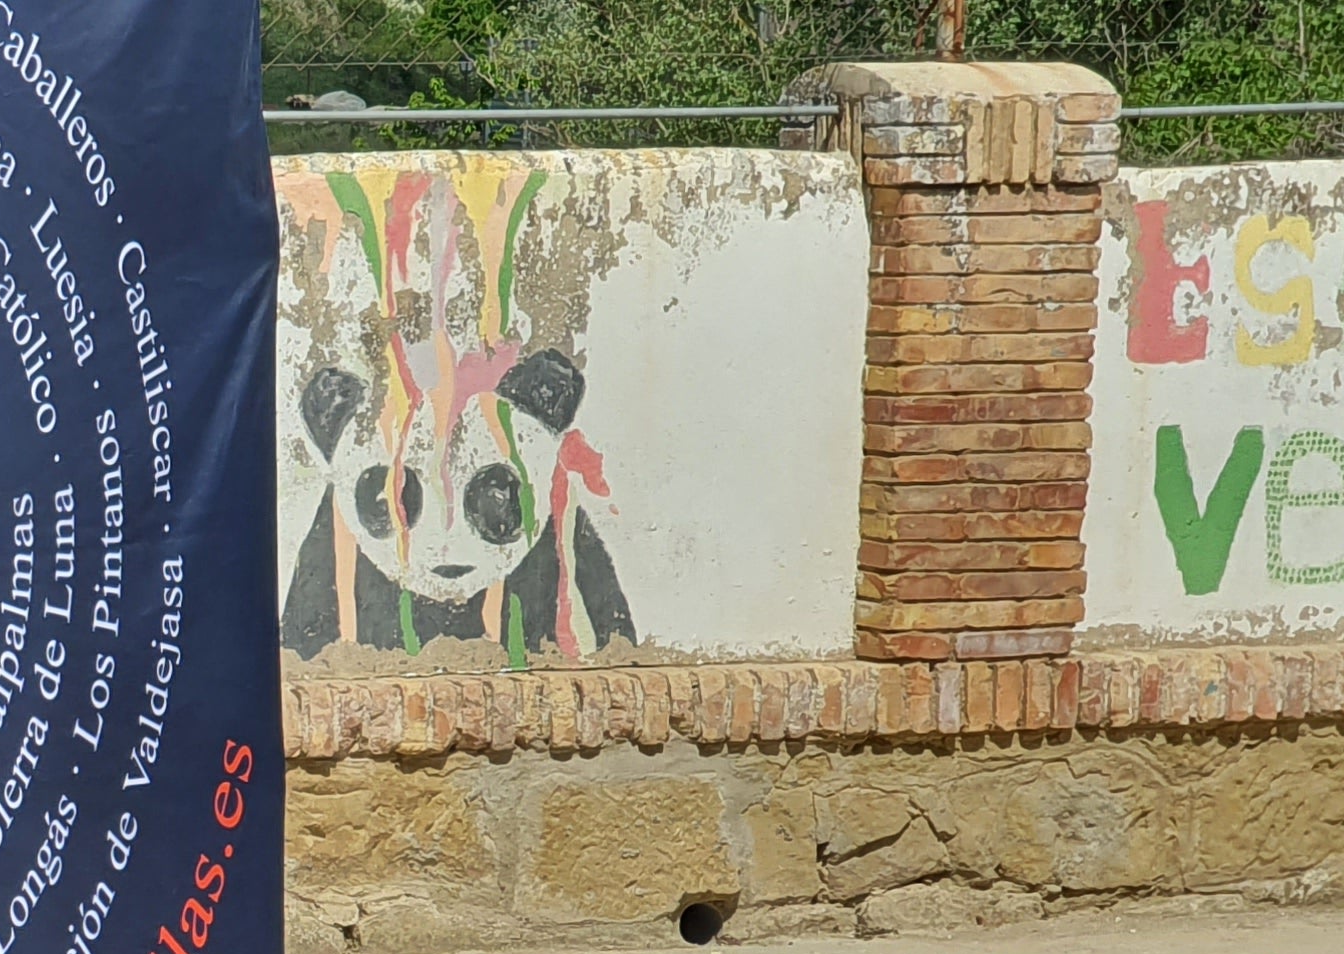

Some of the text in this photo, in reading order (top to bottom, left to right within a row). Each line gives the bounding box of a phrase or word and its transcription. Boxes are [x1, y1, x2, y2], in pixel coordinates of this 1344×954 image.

[30, 198, 96, 367] Luesia
[118, 240, 173, 502] Castiliscar
[43, 483, 75, 623] Luna
[92, 408, 122, 637] Pintanos
[34, 639, 66, 701] de
[73, 653, 116, 751] Los
[106, 811, 138, 871] de
[122, 555, 184, 790] Valdejasa
